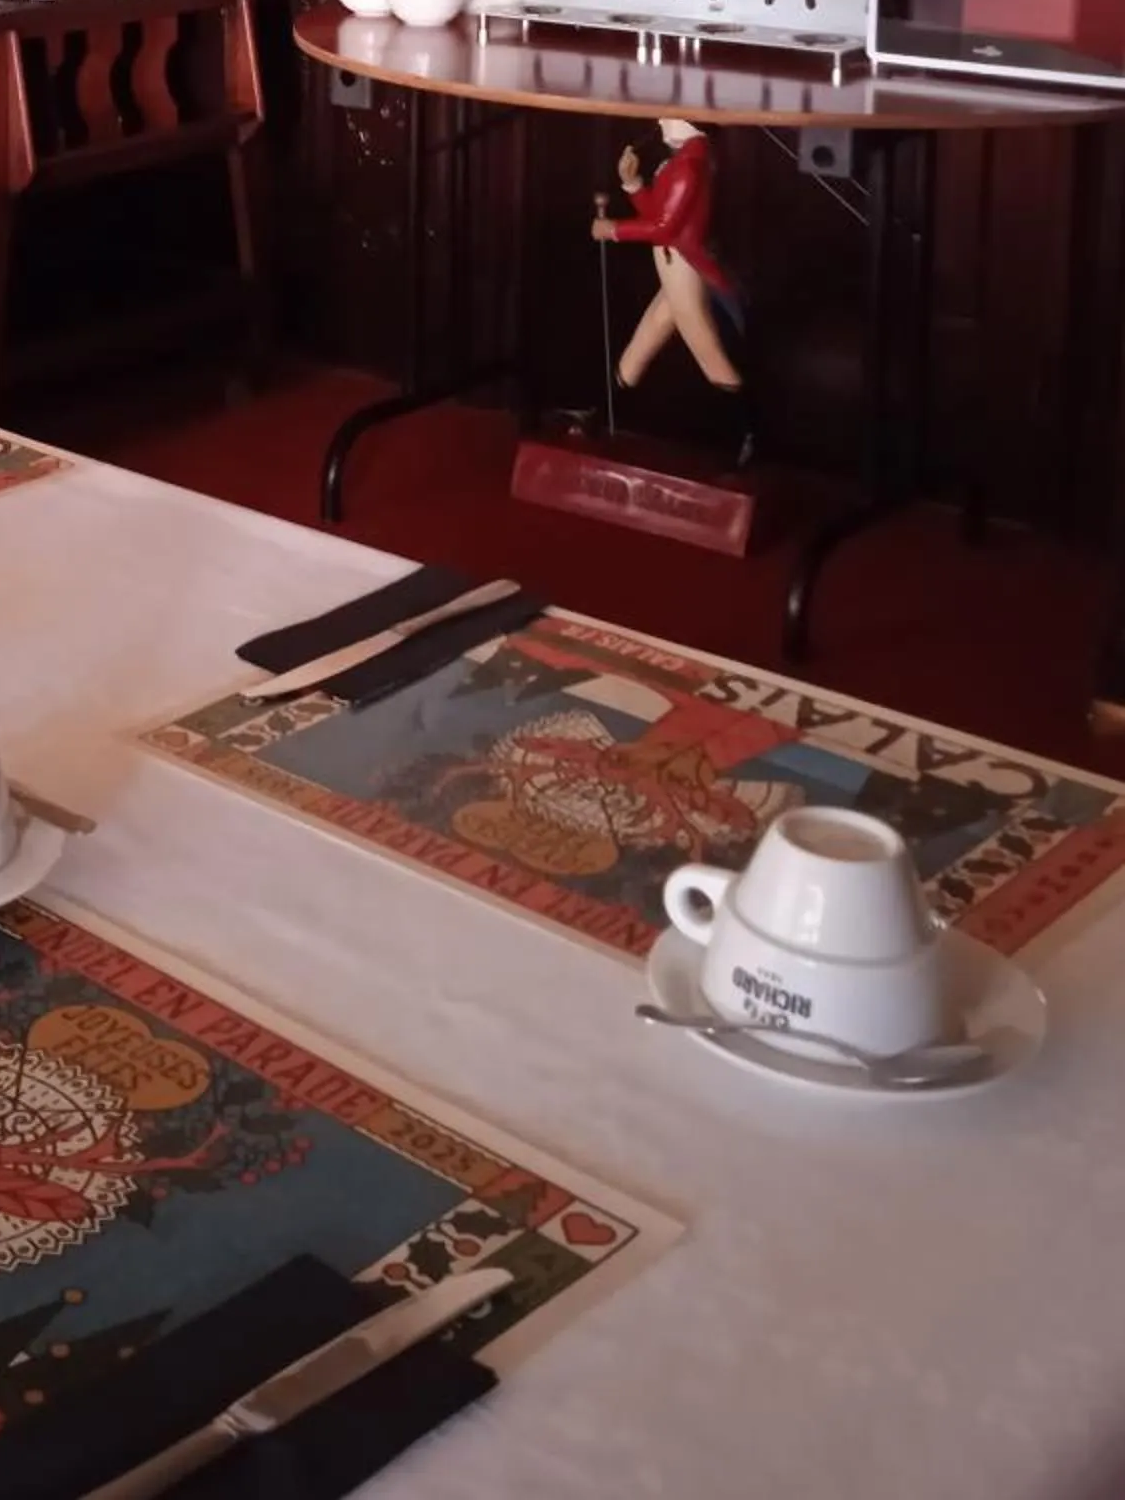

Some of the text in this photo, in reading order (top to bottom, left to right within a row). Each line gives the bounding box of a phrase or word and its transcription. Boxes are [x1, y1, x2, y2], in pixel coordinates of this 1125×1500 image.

[61, 1004, 209, 1092] JOYEUSES
[131, 978, 205, 1019] EN
[195, 1014, 376, 1127] PARADE
